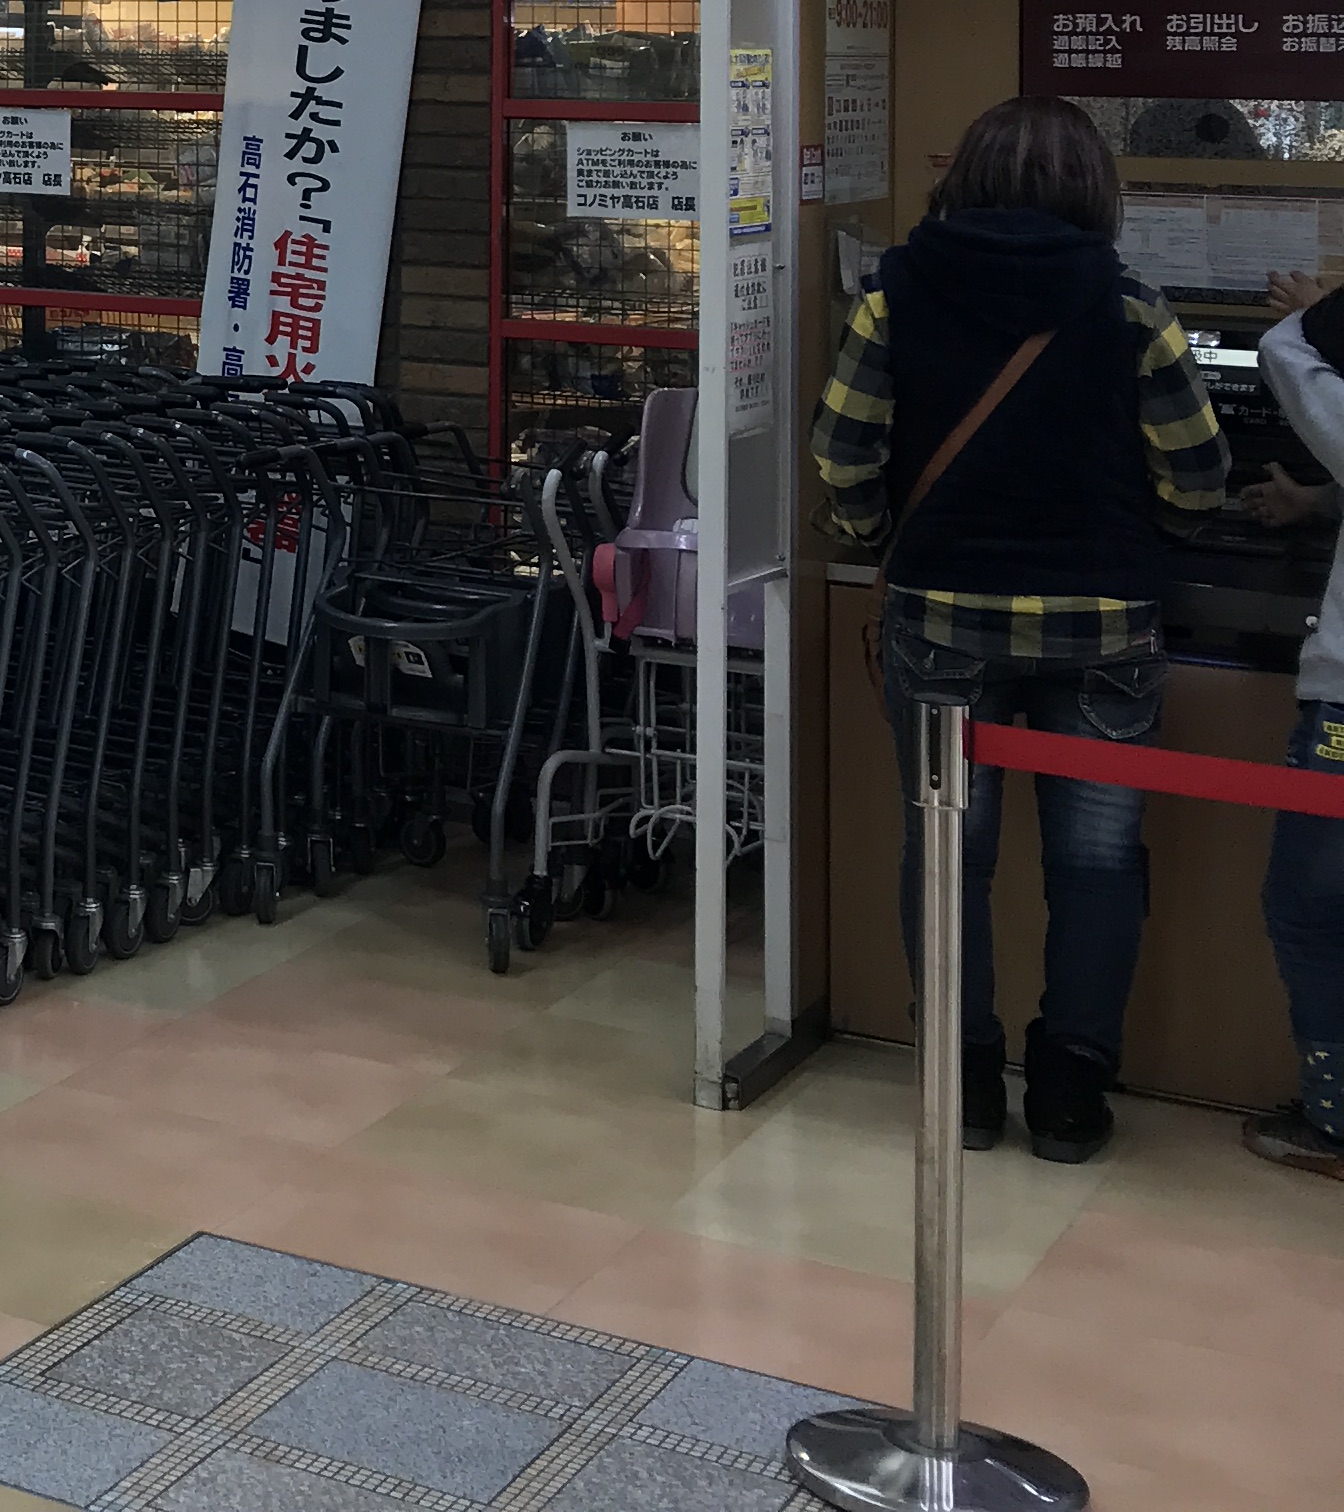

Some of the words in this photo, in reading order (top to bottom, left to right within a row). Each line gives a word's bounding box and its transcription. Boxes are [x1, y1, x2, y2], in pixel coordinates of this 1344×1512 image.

[1053, 14, 1143, 33] お預入れ
[1166, 14, 1259, 33] お引出し
[1052, 36, 1122, 50] 通帳記入
[1166, 36, 1238, 51] 残高照会
[1052, 53, 1122, 68] 通帳繰越
[2, 116, 28, 125] お願い
[621, 132, 653, 142] お願い
[576, 147, 660, 158] ショッピングカートは
[576, 158, 698, 170] ATMをご利用のお客様の為に
[42, 173, 62, 187] 店長
[576, 168, 678, 180] 奥まで差し込んで頂くよう
[576, 179, 669, 191] ご協力お願い致します。
[671, 196, 696, 211] 店長
